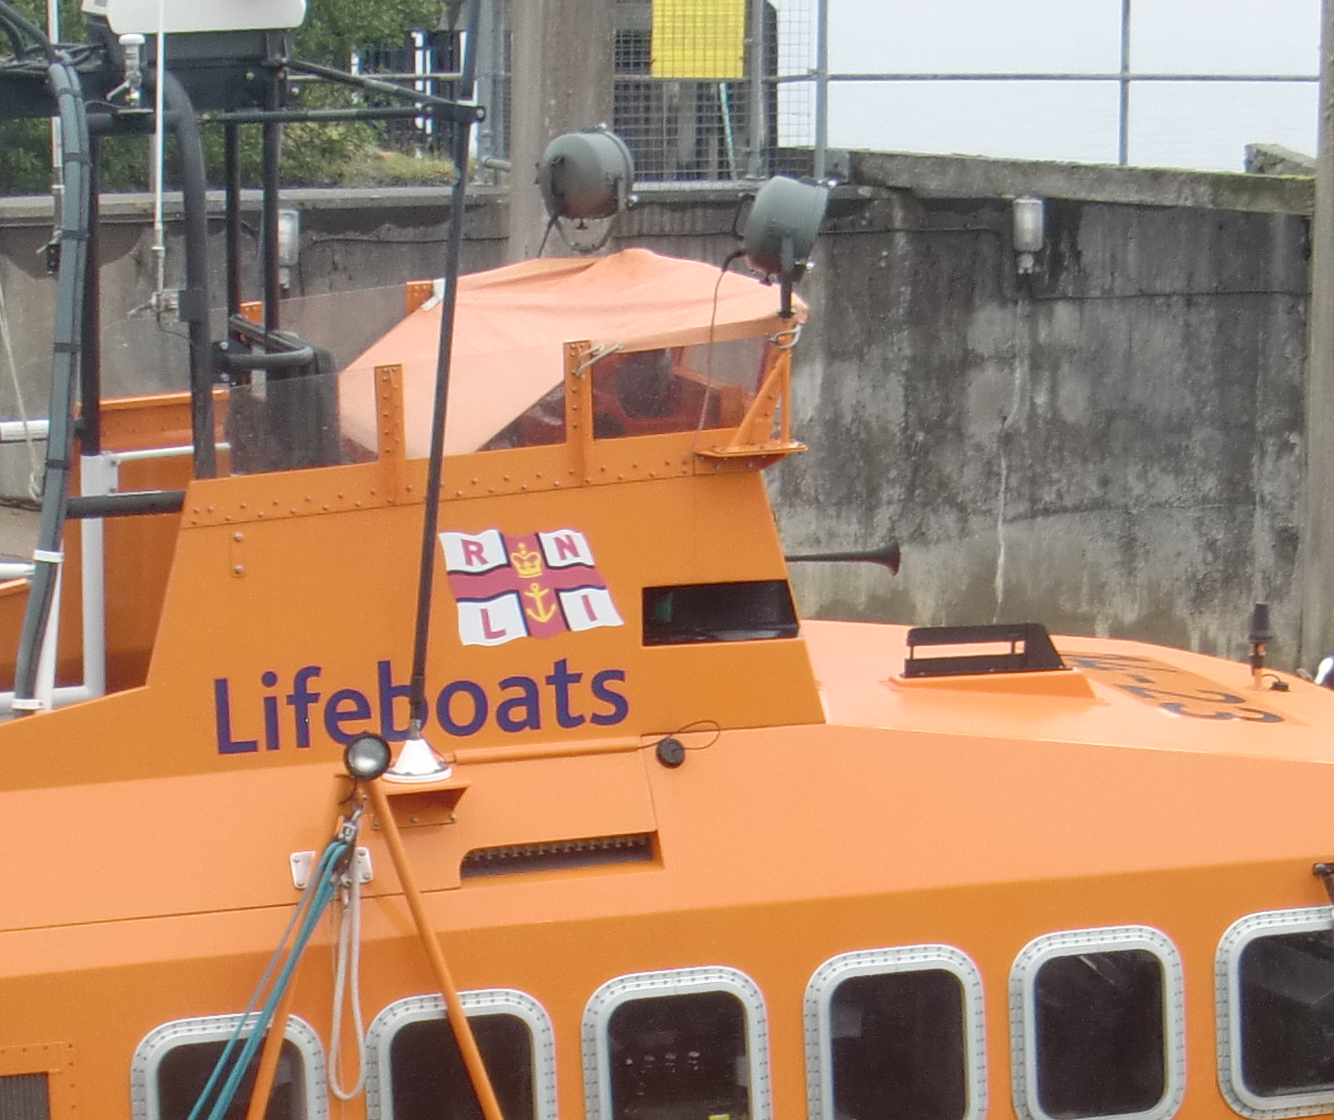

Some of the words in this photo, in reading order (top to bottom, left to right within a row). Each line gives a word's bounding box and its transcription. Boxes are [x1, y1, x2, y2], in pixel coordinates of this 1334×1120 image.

[460, 538, 489, 567] R
[554, 533, 581, 561] N
[479, 607, 507, 640] L
[582, 594, 598, 622] I
[213, 658, 630, 755] Lifeboats
